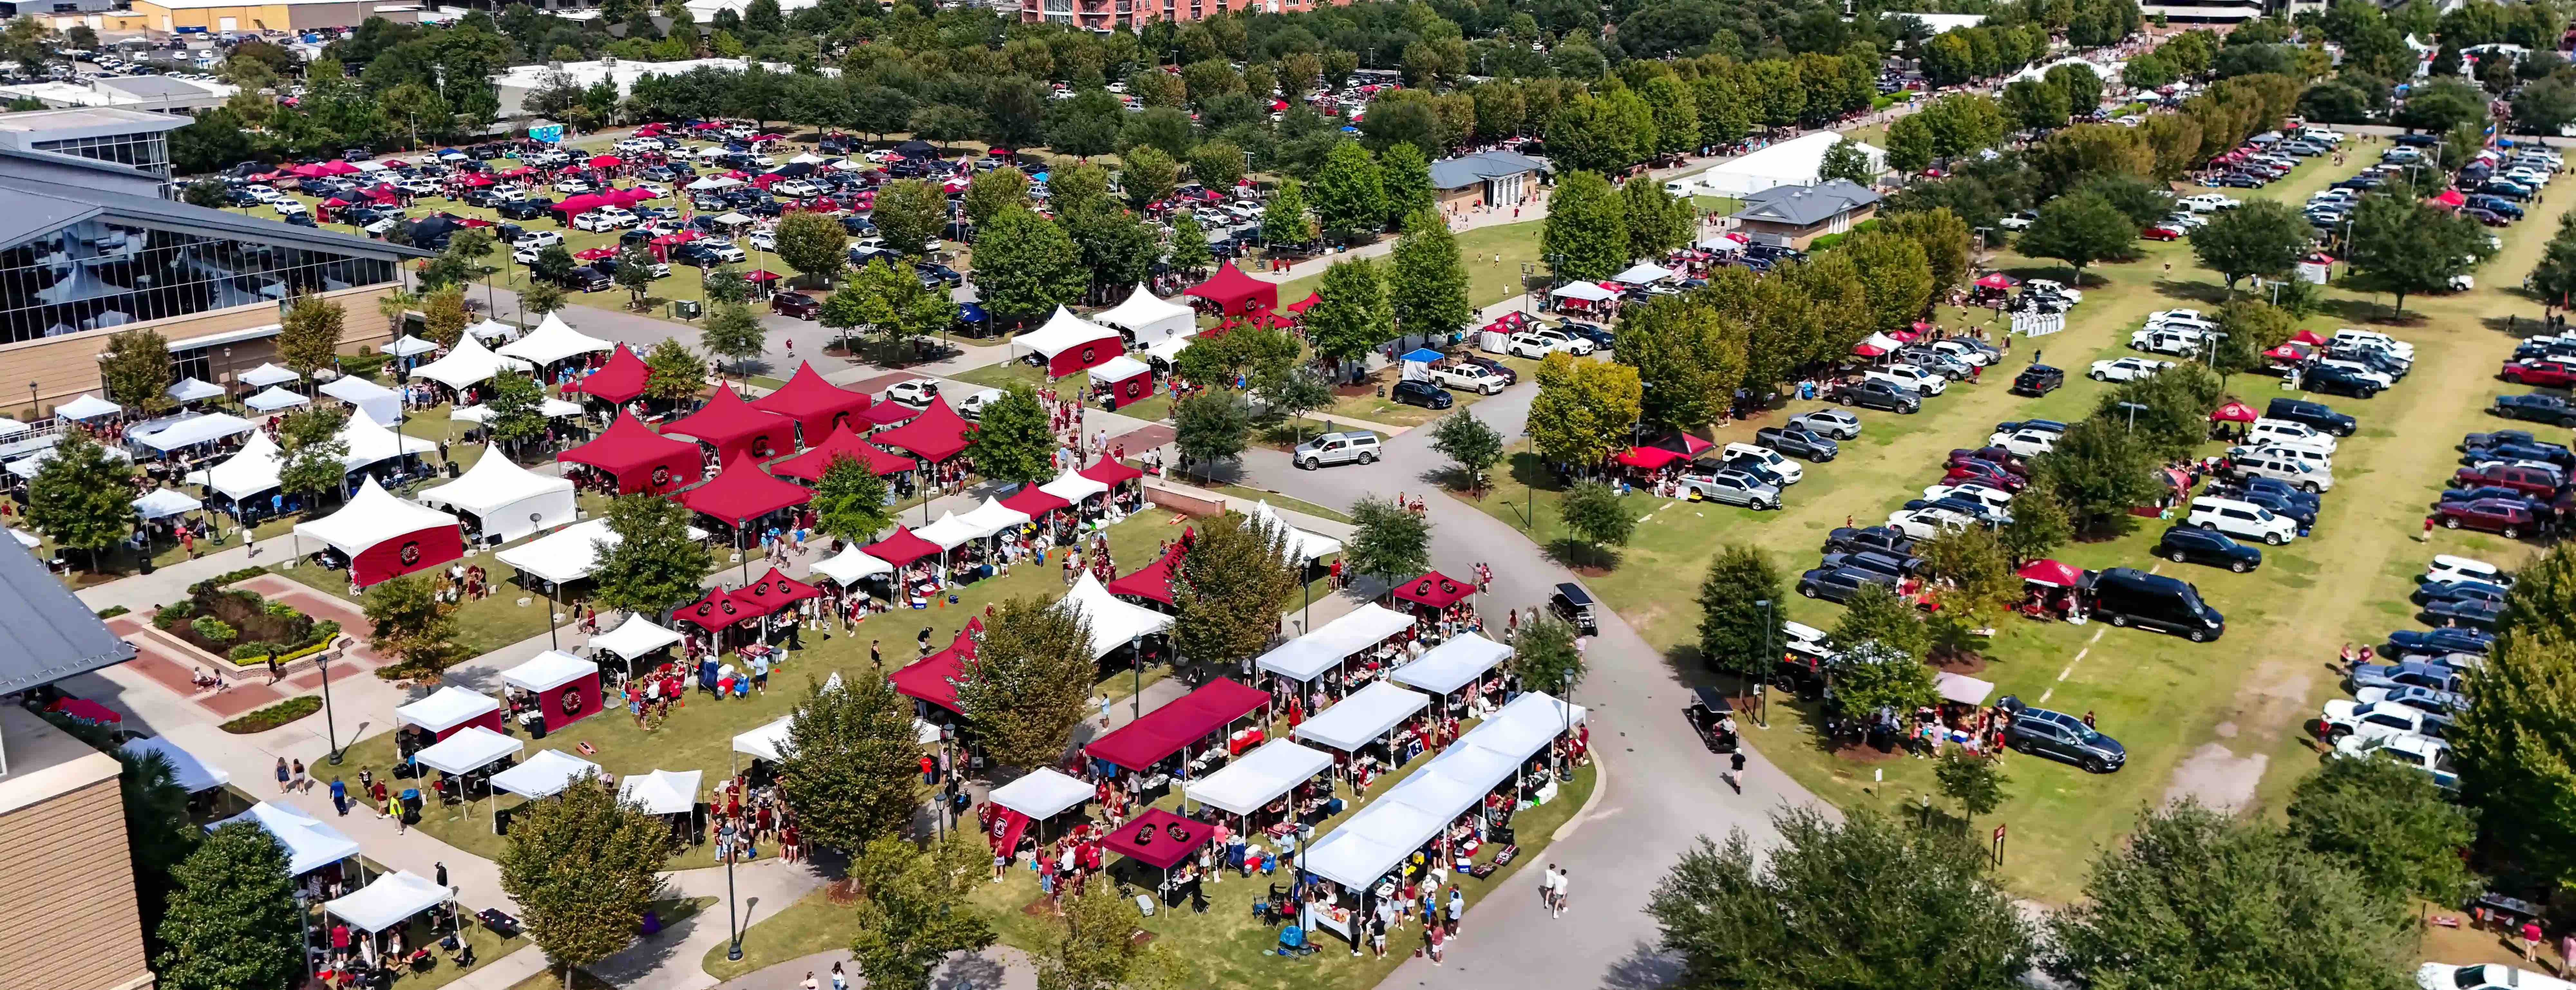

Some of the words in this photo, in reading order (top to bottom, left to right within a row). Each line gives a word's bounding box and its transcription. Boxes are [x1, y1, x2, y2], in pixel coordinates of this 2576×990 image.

[652, 465, 669, 487] C
[401, 541, 420, 566] C
[562, 686, 582, 717] C
[1134, 823, 1157, 845] C
[1167, 822, 1190, 842] C
